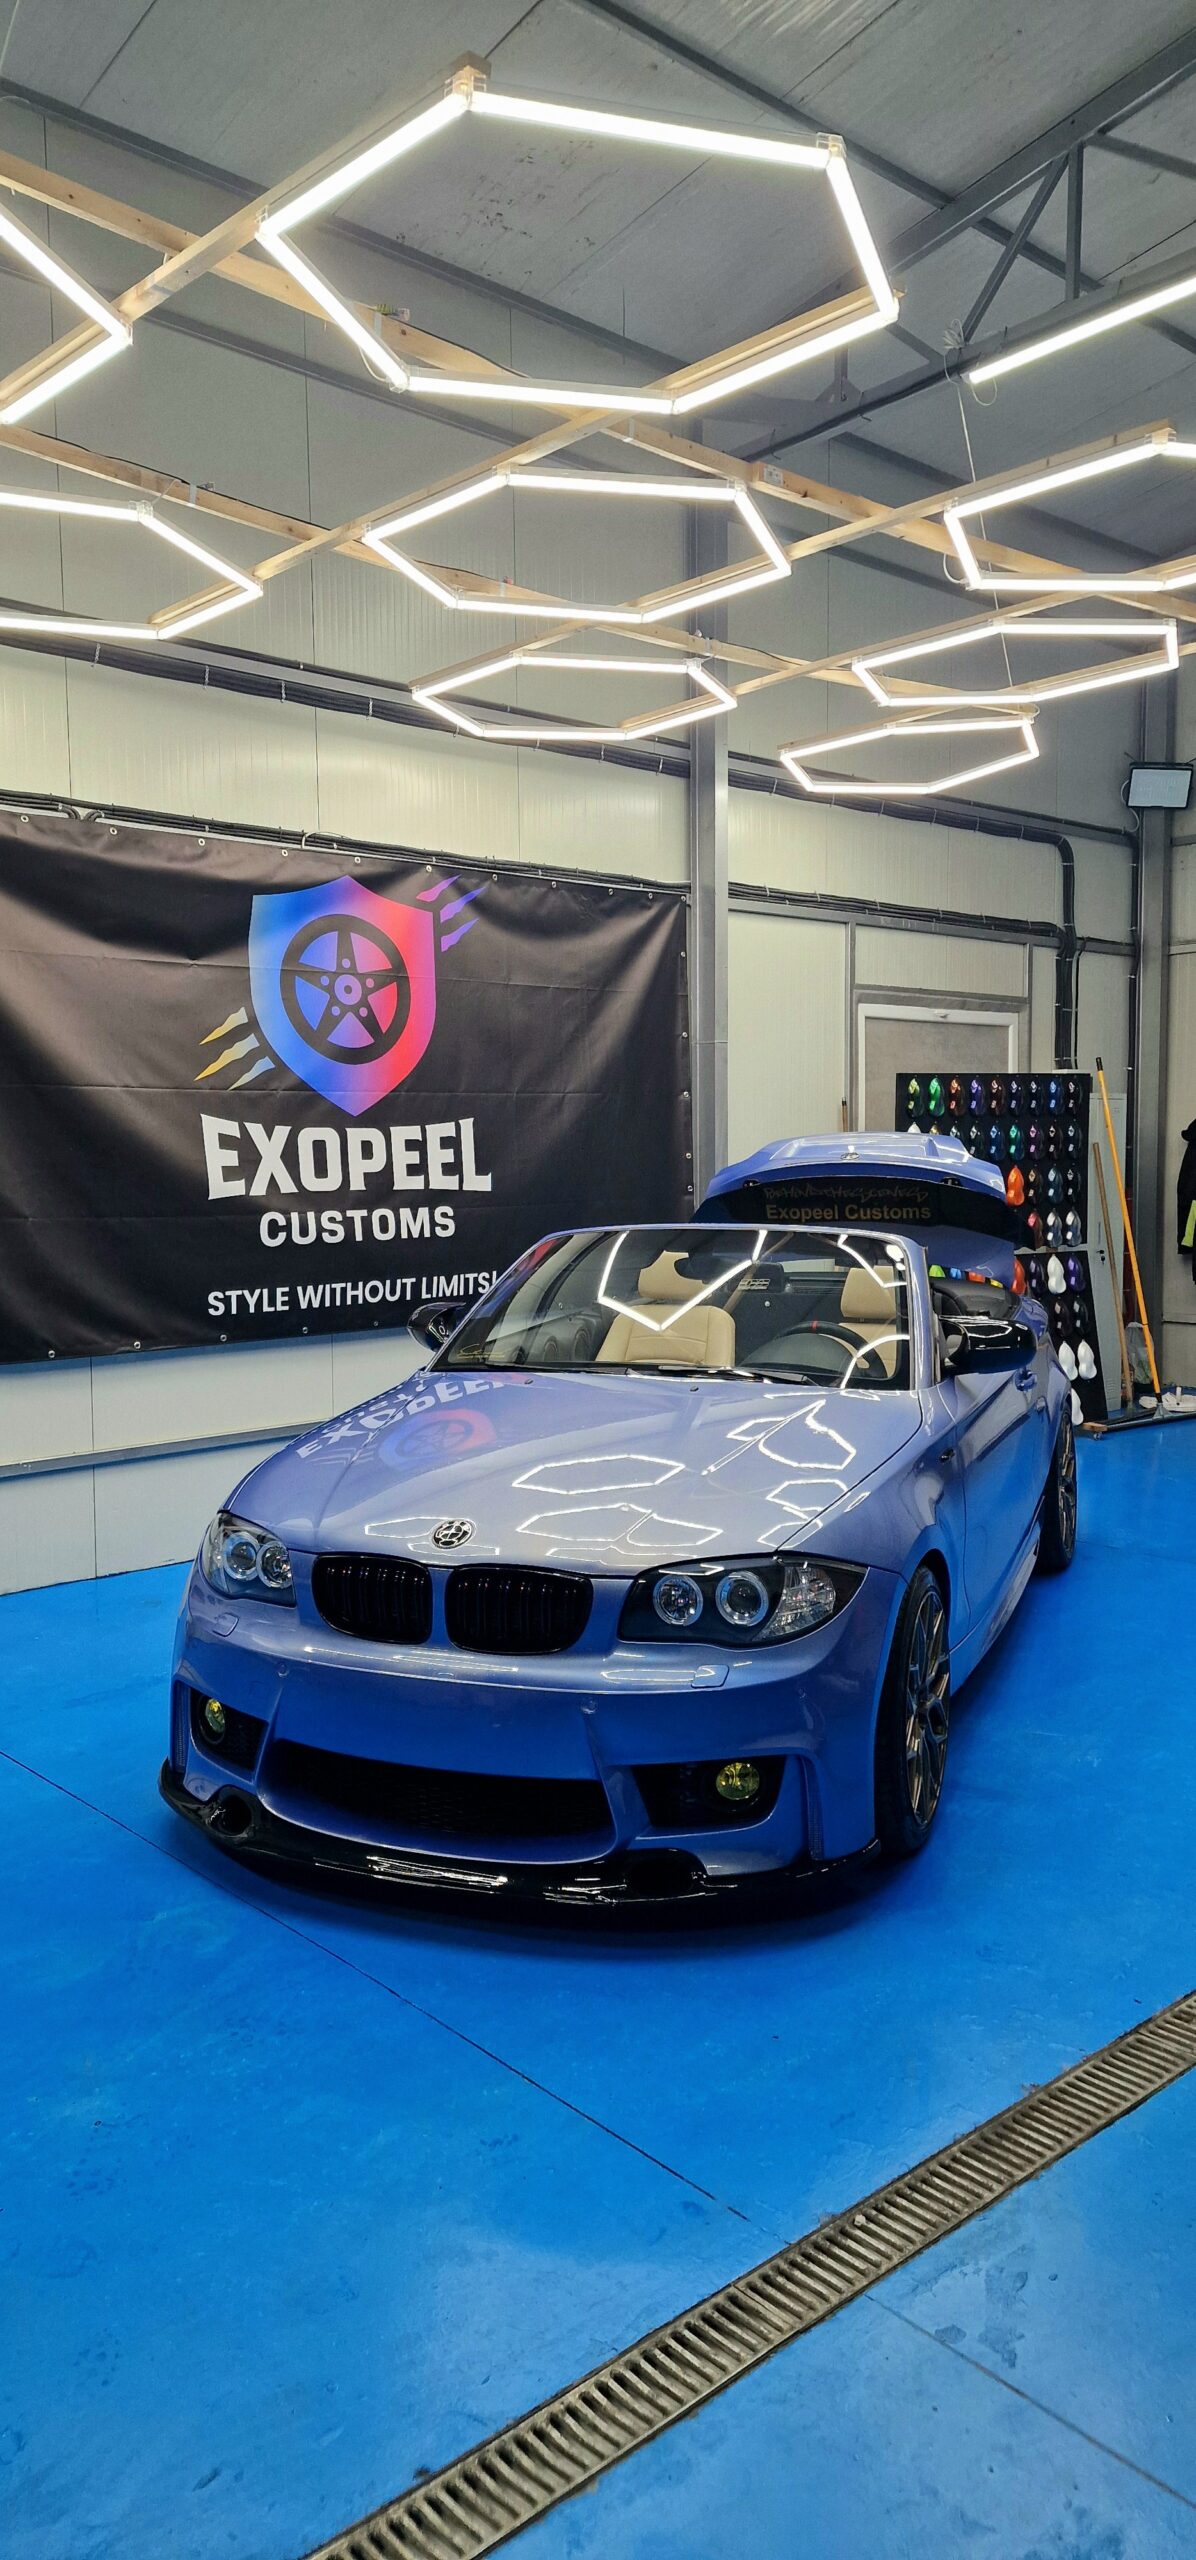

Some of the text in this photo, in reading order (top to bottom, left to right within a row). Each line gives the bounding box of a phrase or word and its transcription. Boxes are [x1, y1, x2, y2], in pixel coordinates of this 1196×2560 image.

[200, 1113, 492, 1200] EXOPEEL
[259, 1206, 456, 1247] CUSTOMS
[766, 1203, 931, 1222] Exopeel Customs
[208, 1287, 289, 1316] STYLE
[297, 1277, 417, 1310] WITHOUT
